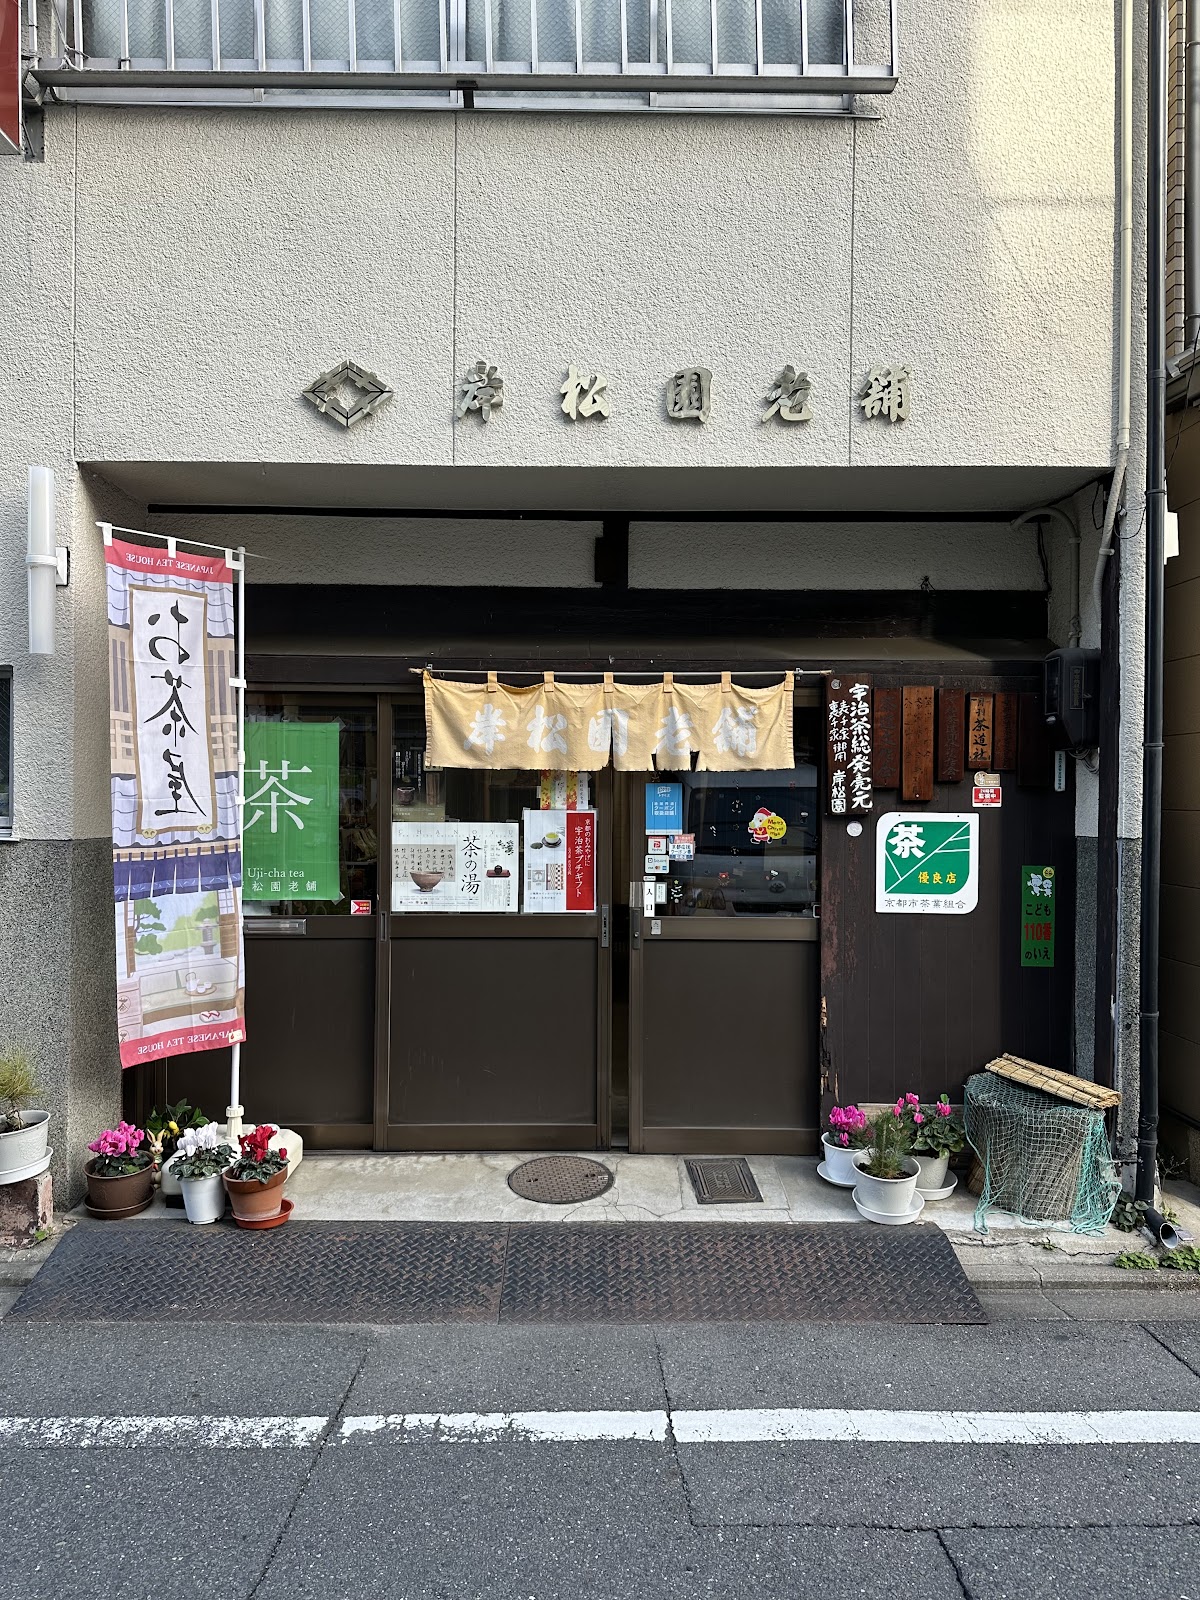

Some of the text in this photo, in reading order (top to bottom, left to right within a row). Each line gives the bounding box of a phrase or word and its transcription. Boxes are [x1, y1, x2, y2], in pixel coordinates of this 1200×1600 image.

[464, 703, 758, 757] 岸松園老舗
[847, 683, 873, 809] 宇治茶総発売元
[243, 760, 314, 834] 茶
[887, 823, 926, 859] 茶
[460, 836, 483, 895] 茶の湯
[247, 868, 305, 880] Uji-cha tea
[917, 871, 957, 884] 優良店
[242, 880, 317, 892] 松園老舗
[884, 898, 966, 909] 京都市茶業組合
[1025, 903, 1051, 916] こども
[1024, 922, 1052, 941] 110番
[1025, 947, 1051, 960] のいえ
